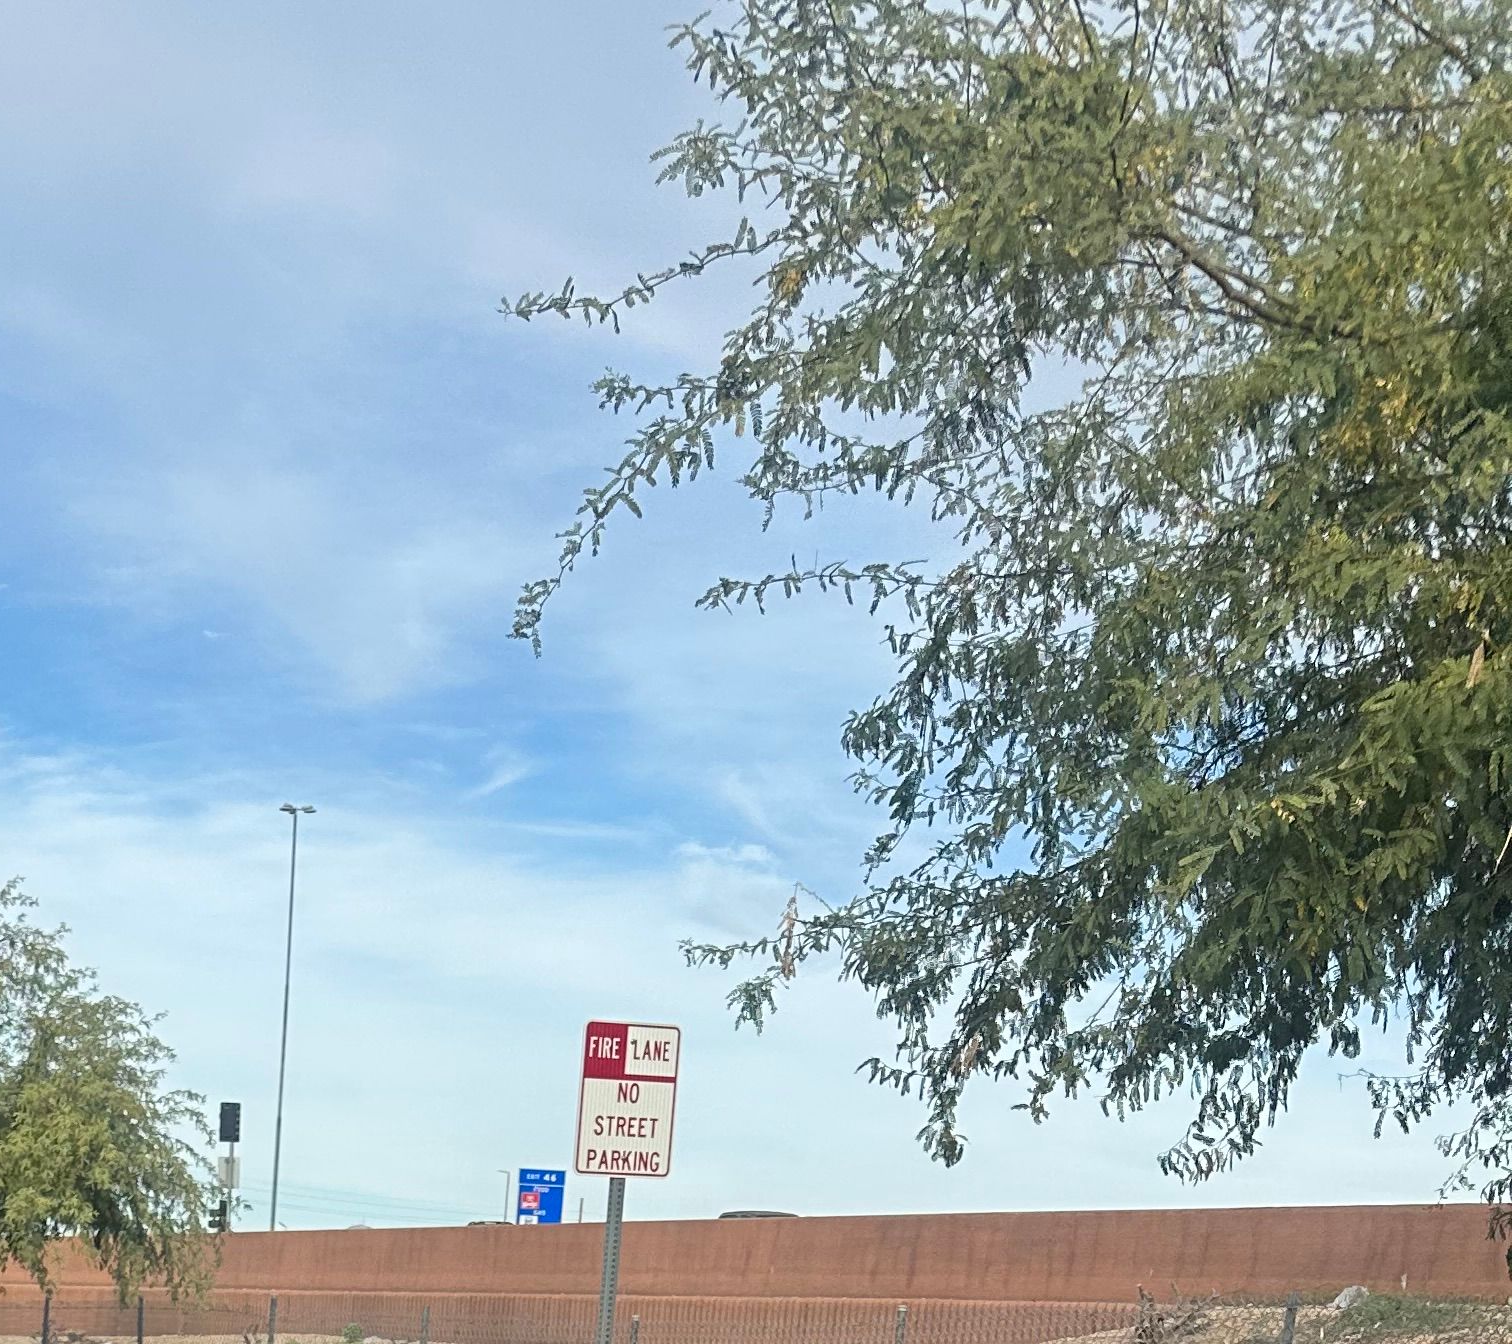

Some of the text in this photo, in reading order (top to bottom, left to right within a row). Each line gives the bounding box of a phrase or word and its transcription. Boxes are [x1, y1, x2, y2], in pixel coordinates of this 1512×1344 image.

[589, 1036, 671, 1062] FIRE LANE
[617, 1083, 640, 1104] NO
[593, 1115, 658, 1138] STREET
[586, 1149, 660, 1172] PARKING
